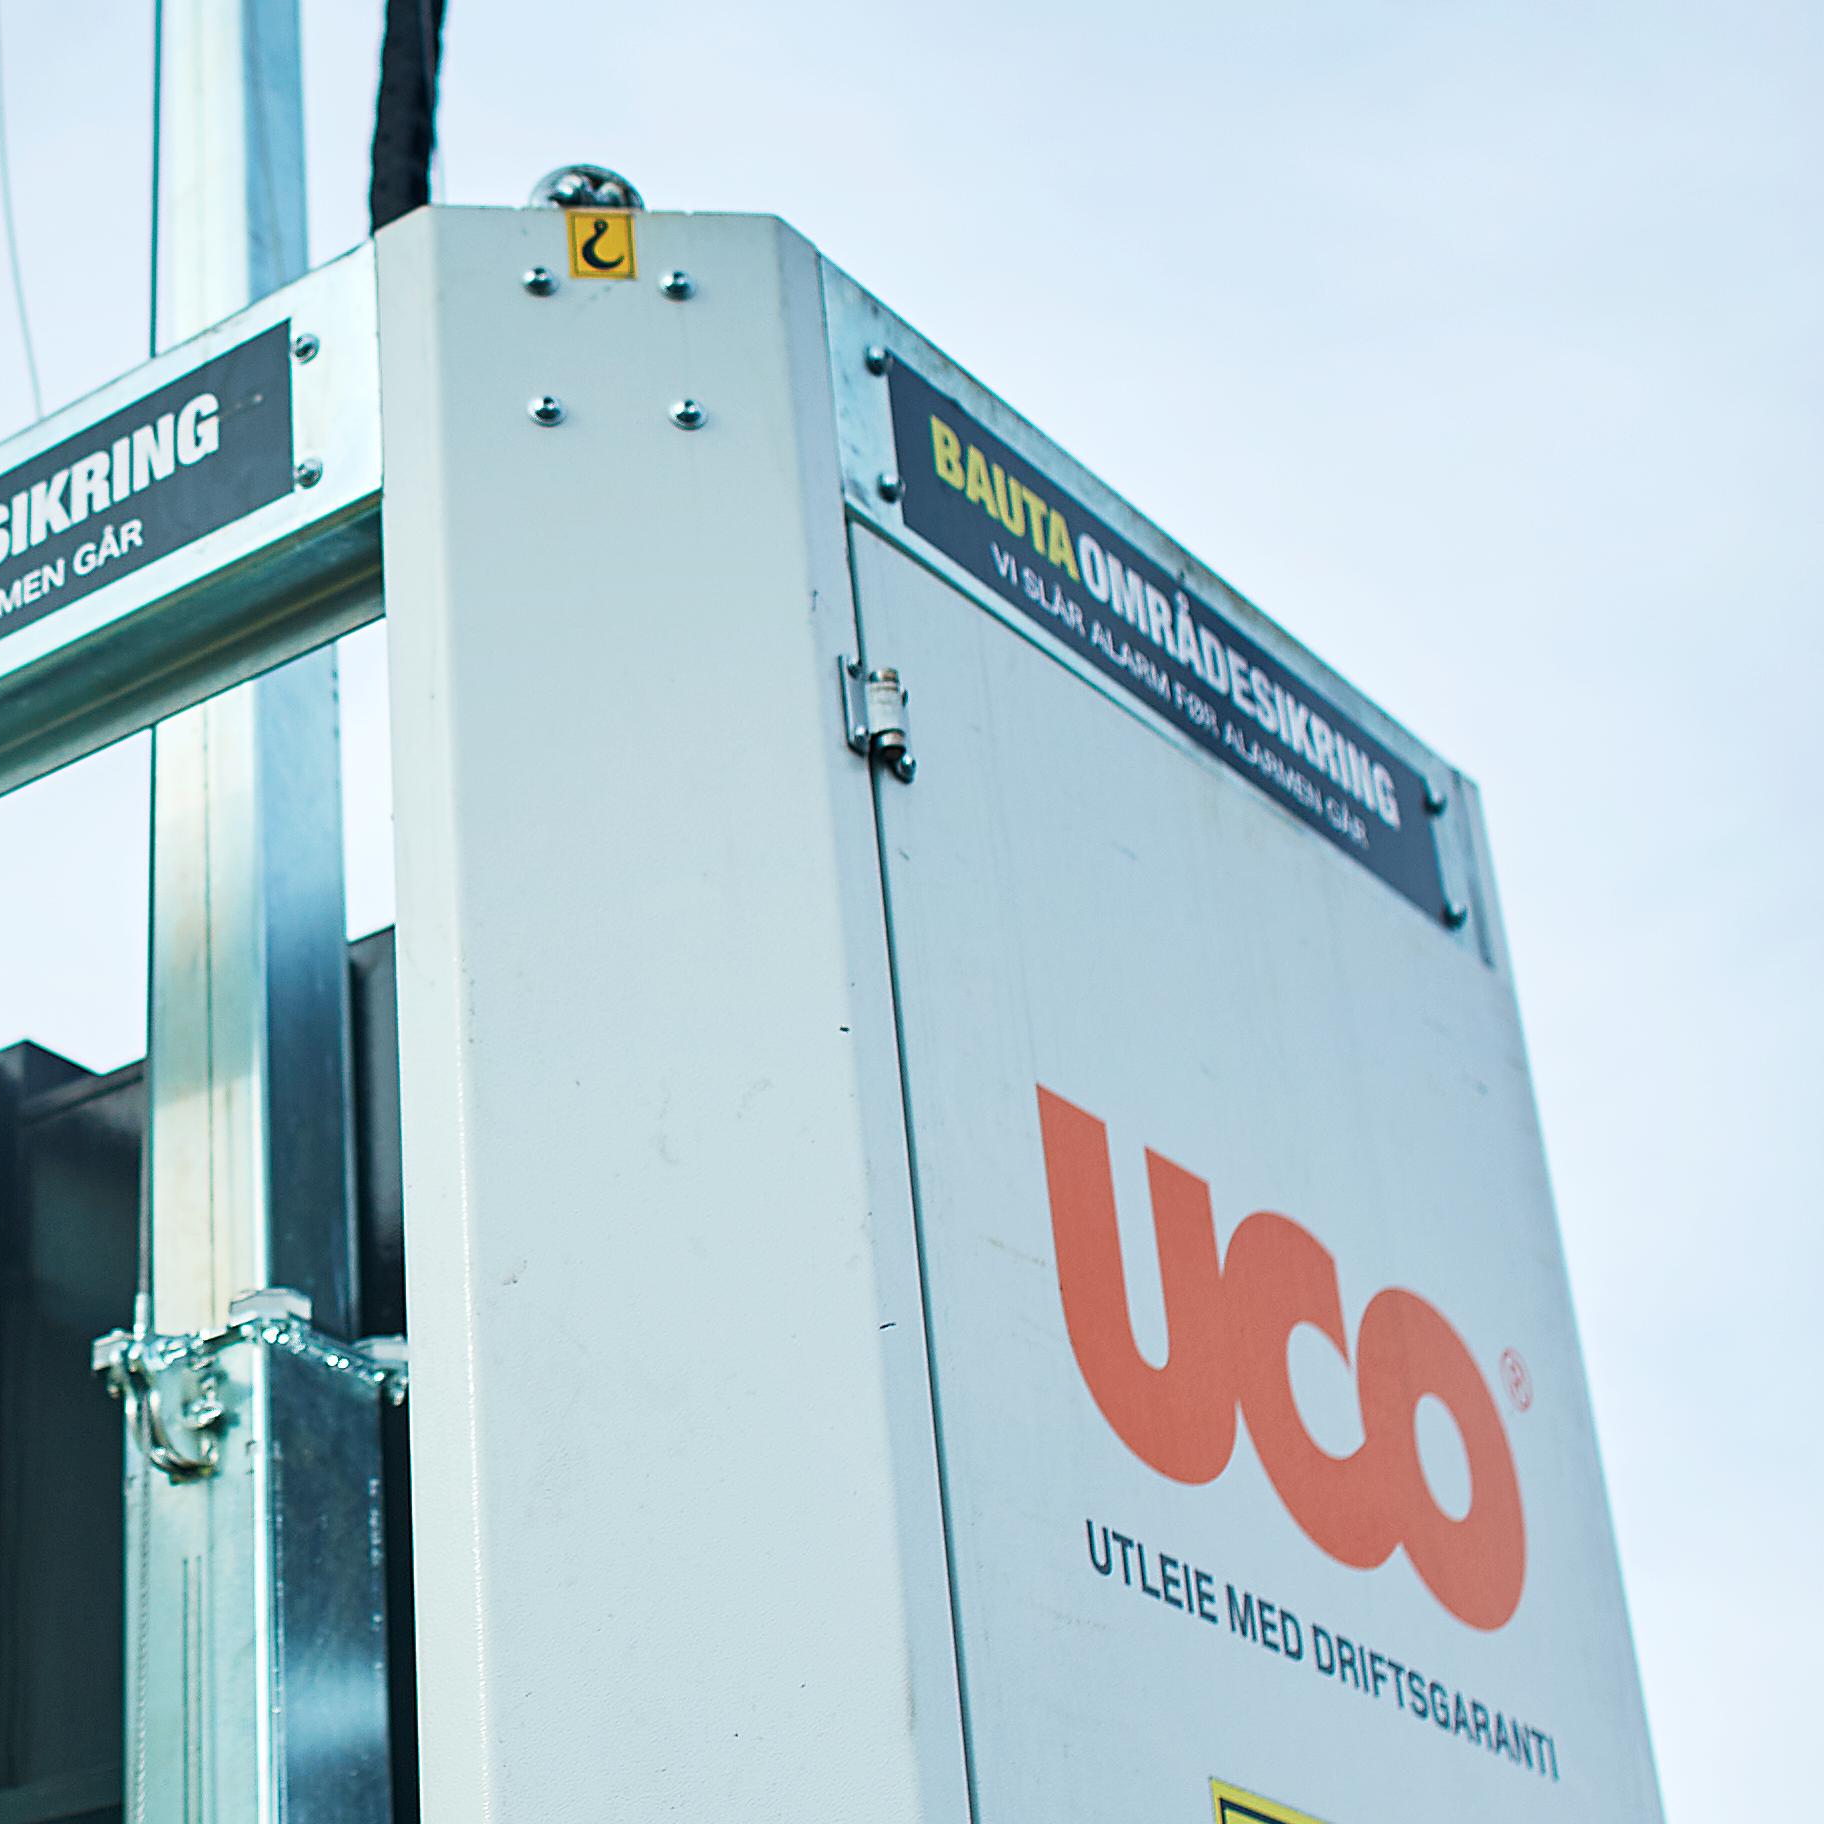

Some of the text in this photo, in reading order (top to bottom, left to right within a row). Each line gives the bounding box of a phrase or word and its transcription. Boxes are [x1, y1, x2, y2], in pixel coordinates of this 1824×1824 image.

[73, 519, 143, 575] GÅR
[990, 540, 1018, 586] VI
[1090, 620, 1171, 703] ALARM
[1222, 720, 1323, 816] ALARMEN
[1086, 1518, 1561, 1782] UTLEIE MED DRIFTSGARANTI
